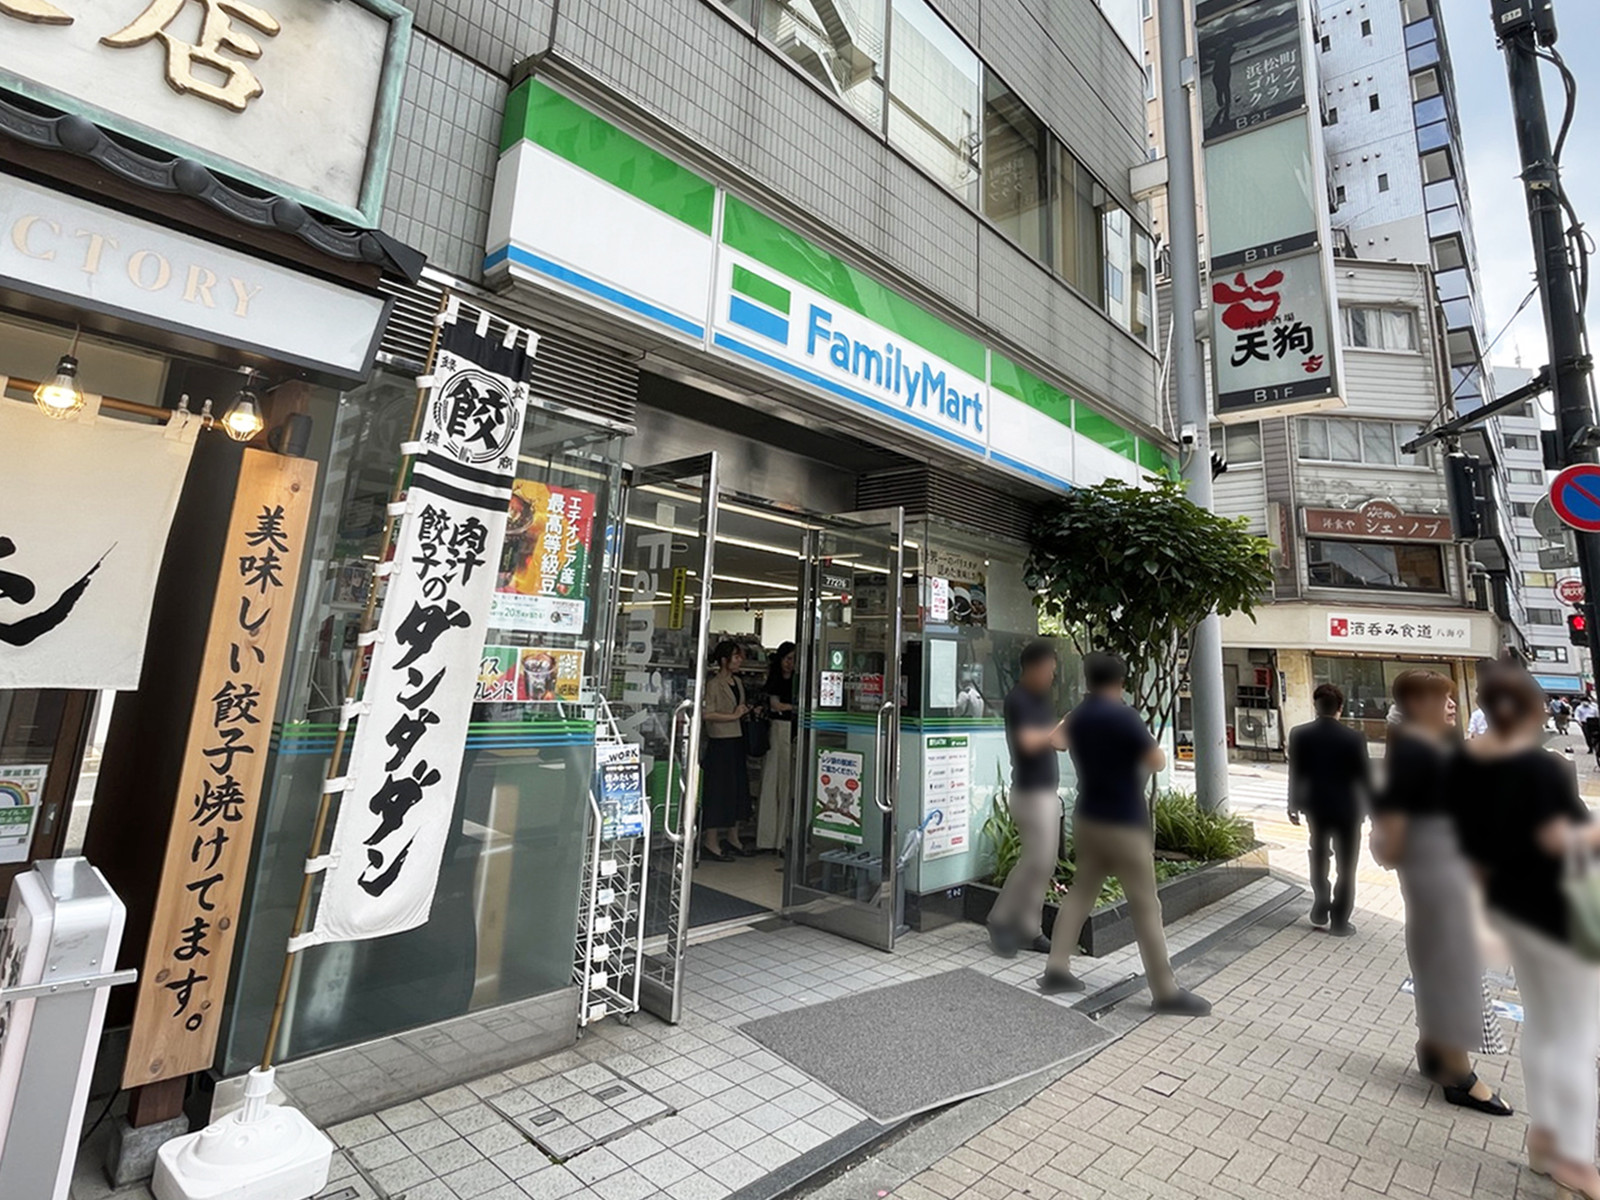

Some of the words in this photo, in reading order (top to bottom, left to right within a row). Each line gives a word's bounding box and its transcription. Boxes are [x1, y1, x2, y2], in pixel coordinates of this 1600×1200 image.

[1247, 49, 1296, 79] 浜松町
[1249, 65, 1297, 92] ゴルフ
[1250, 76, 1299, 107] クラブ
[1235, 110, 1273, 130] B2F
[11, 212, 263, 319] CTORY
[1245, 244, 1283, 262] B1F
[807, 303, 983, 432] FamilyMart
[1231, 322, 1314, 367] 天狗
[445, 377, 509, 450] 餃
[1254, 387, 1294, 403] B1F
[412, 503, 453, 600] 餃子の
[441, 515, 488, 587] 肉汁
[537, 492, 566, 596] 最高等級豆
[560, 496, 583, 586] エチオピア産
[1364, 518, 1442, 538] シェ・ノブ
[1350, 621, 1432, 640] 酒呑み食道
[163, 504, 290, 1032] 美味しい餃子焼けてます。
[358, 598, 472, 898] ダンダダン
